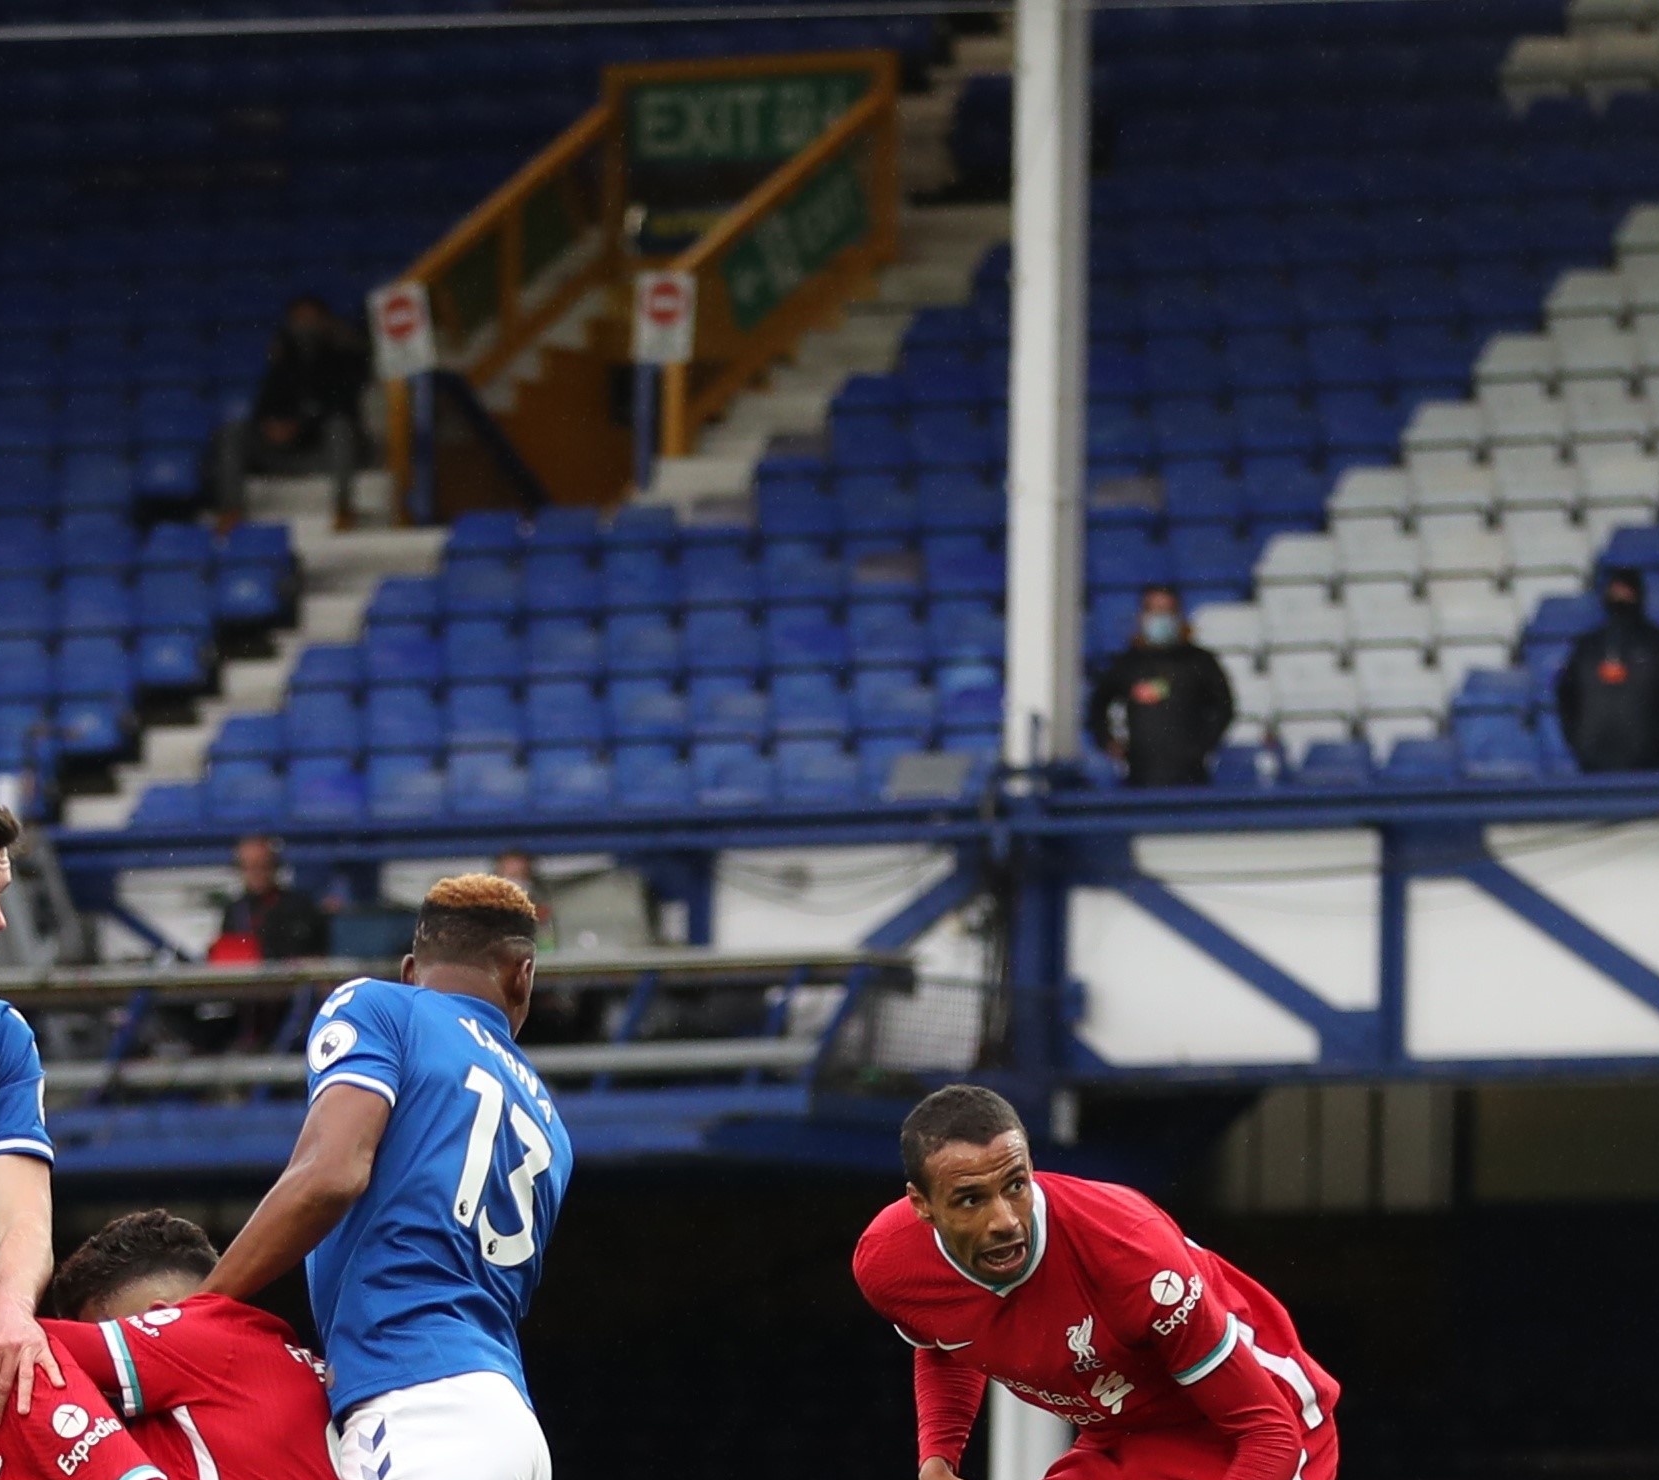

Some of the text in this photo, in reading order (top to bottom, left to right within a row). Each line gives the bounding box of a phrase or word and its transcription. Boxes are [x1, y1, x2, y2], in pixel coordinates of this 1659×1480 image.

[638, 88, 766, 156] EXIT
[453, 1064, 552, 1267] 13
[57, 1416, 123, 1476] Expedia
